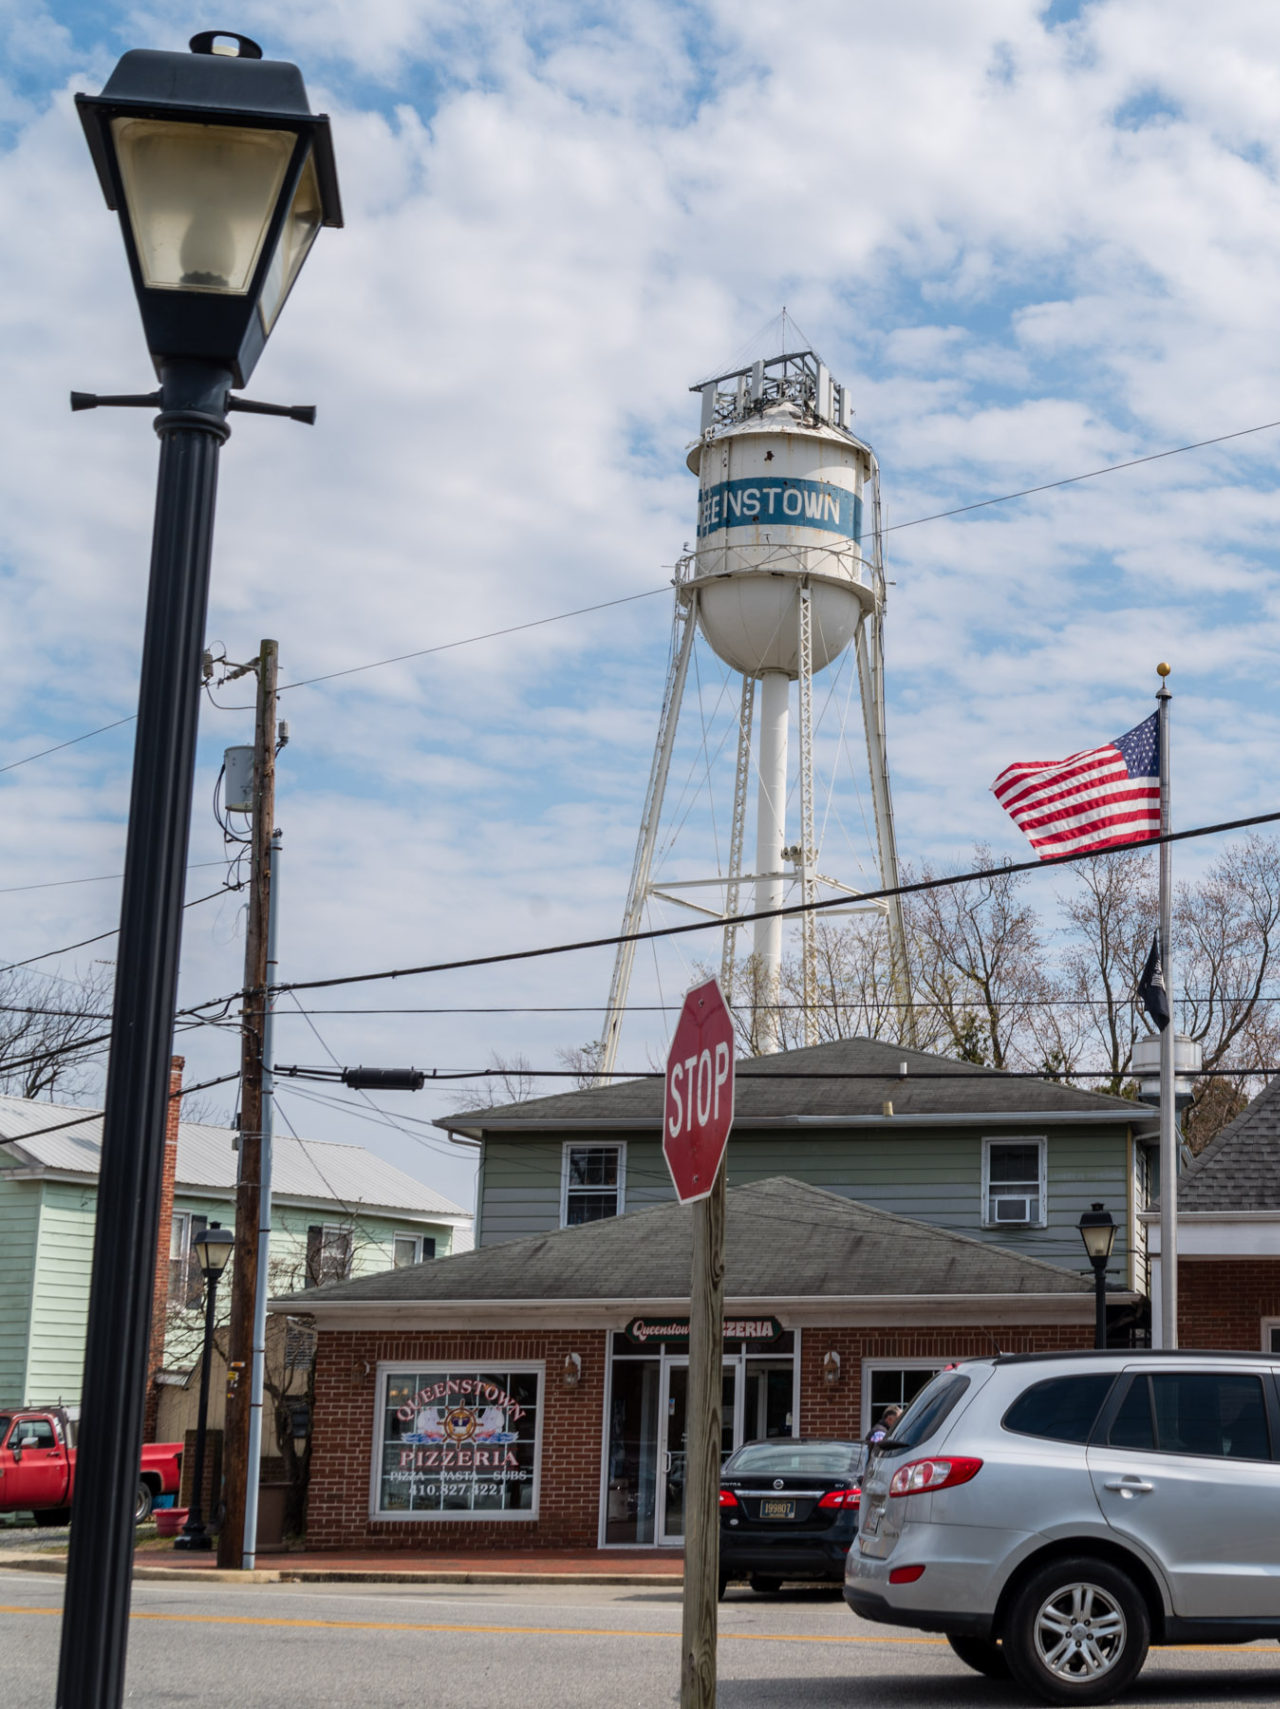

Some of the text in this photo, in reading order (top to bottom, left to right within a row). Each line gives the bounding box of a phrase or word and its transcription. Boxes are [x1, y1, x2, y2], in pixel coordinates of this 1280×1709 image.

[668, 1041, 730, 1139] STOP
[396, 1379, 527, 1422] QUEENSTOWN
[400, 1451, 519, 1467] PIZZERIA
[390, 1471, 527, 1482] PIZZA PASTA SUBS
[409, 1484, 504, 1496] 410.827.4221
